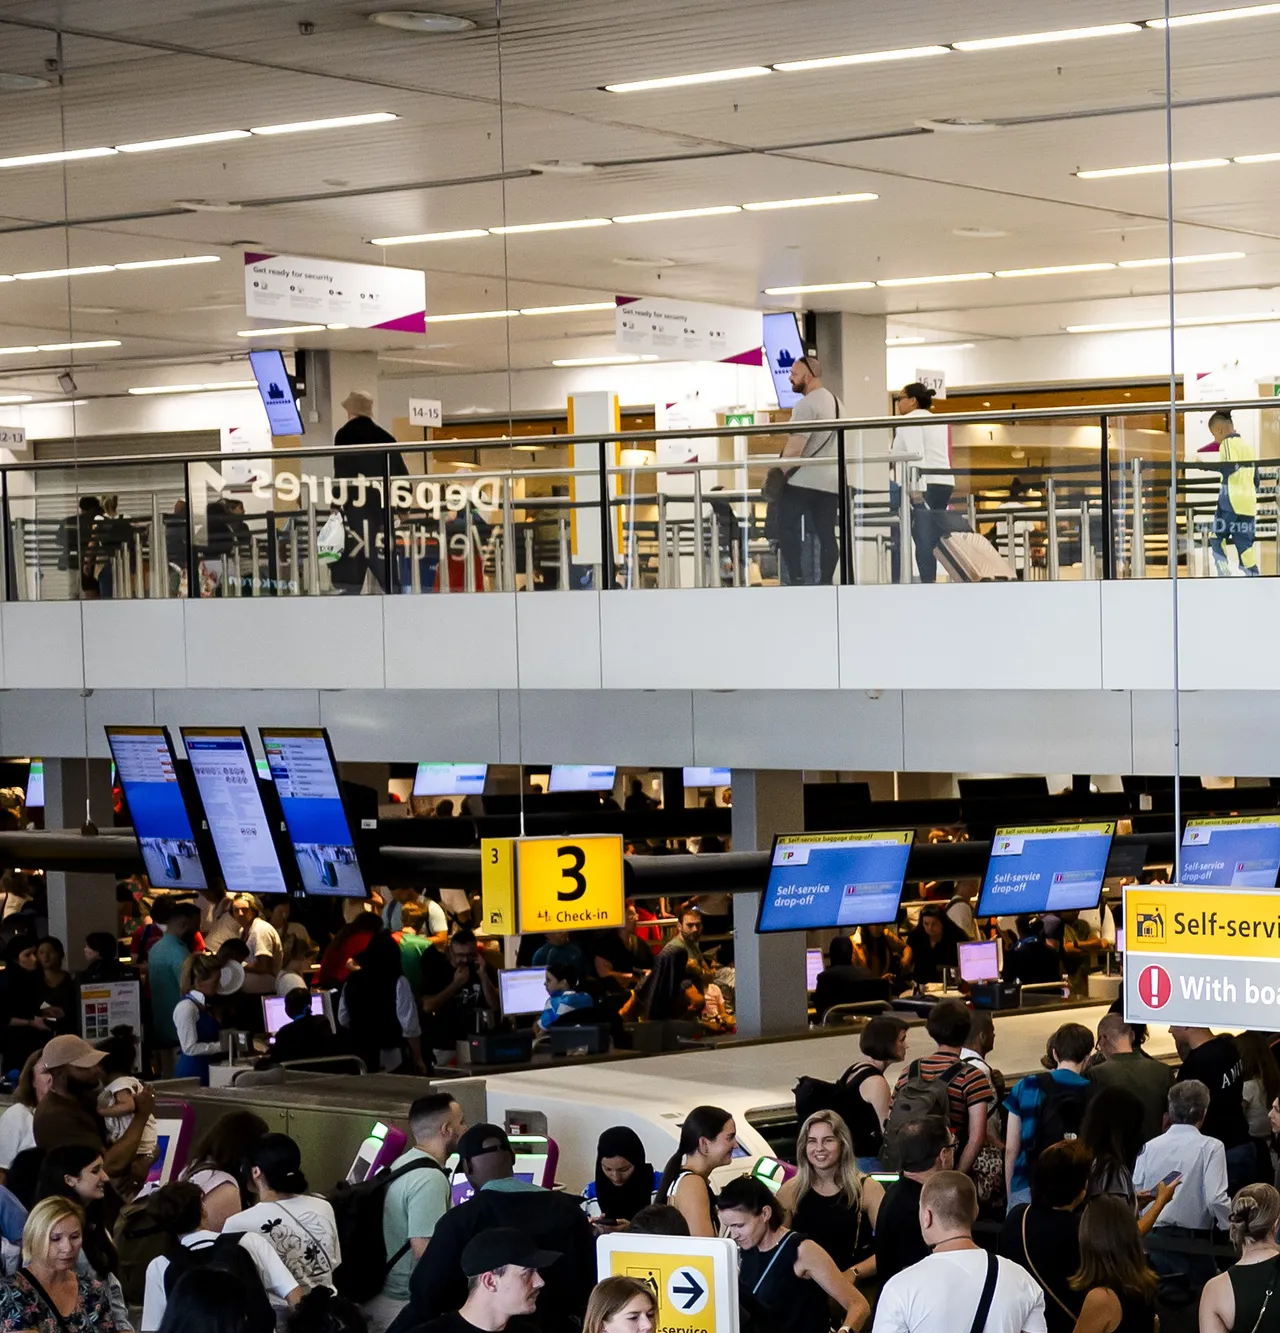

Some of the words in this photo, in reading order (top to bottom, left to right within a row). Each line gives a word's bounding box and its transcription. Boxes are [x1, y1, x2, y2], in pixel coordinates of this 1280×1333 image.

[253, 266, 267, 274] Get
[268, 269, 290, 278] ready
[291, 270, 303, 278] for
[304, 273, 334, 283] security
[413, 407, 439, 419] 14-15
[1104, 824, 1111, 834] 2
[903, 832, 908, 843] 1
[490, 847, 499, 865] 3
[557, 845, 587, 902] 3
[994, 871, 1041, 883] Self-service
[776, 884, 830, 895] Self-service
[991, 882, 1027, 895] drop-off
[774, 895, 815, 908] drop-off
[556, 909, 609, 923] Check-in
[1180, 974, 1237, 1003] With
